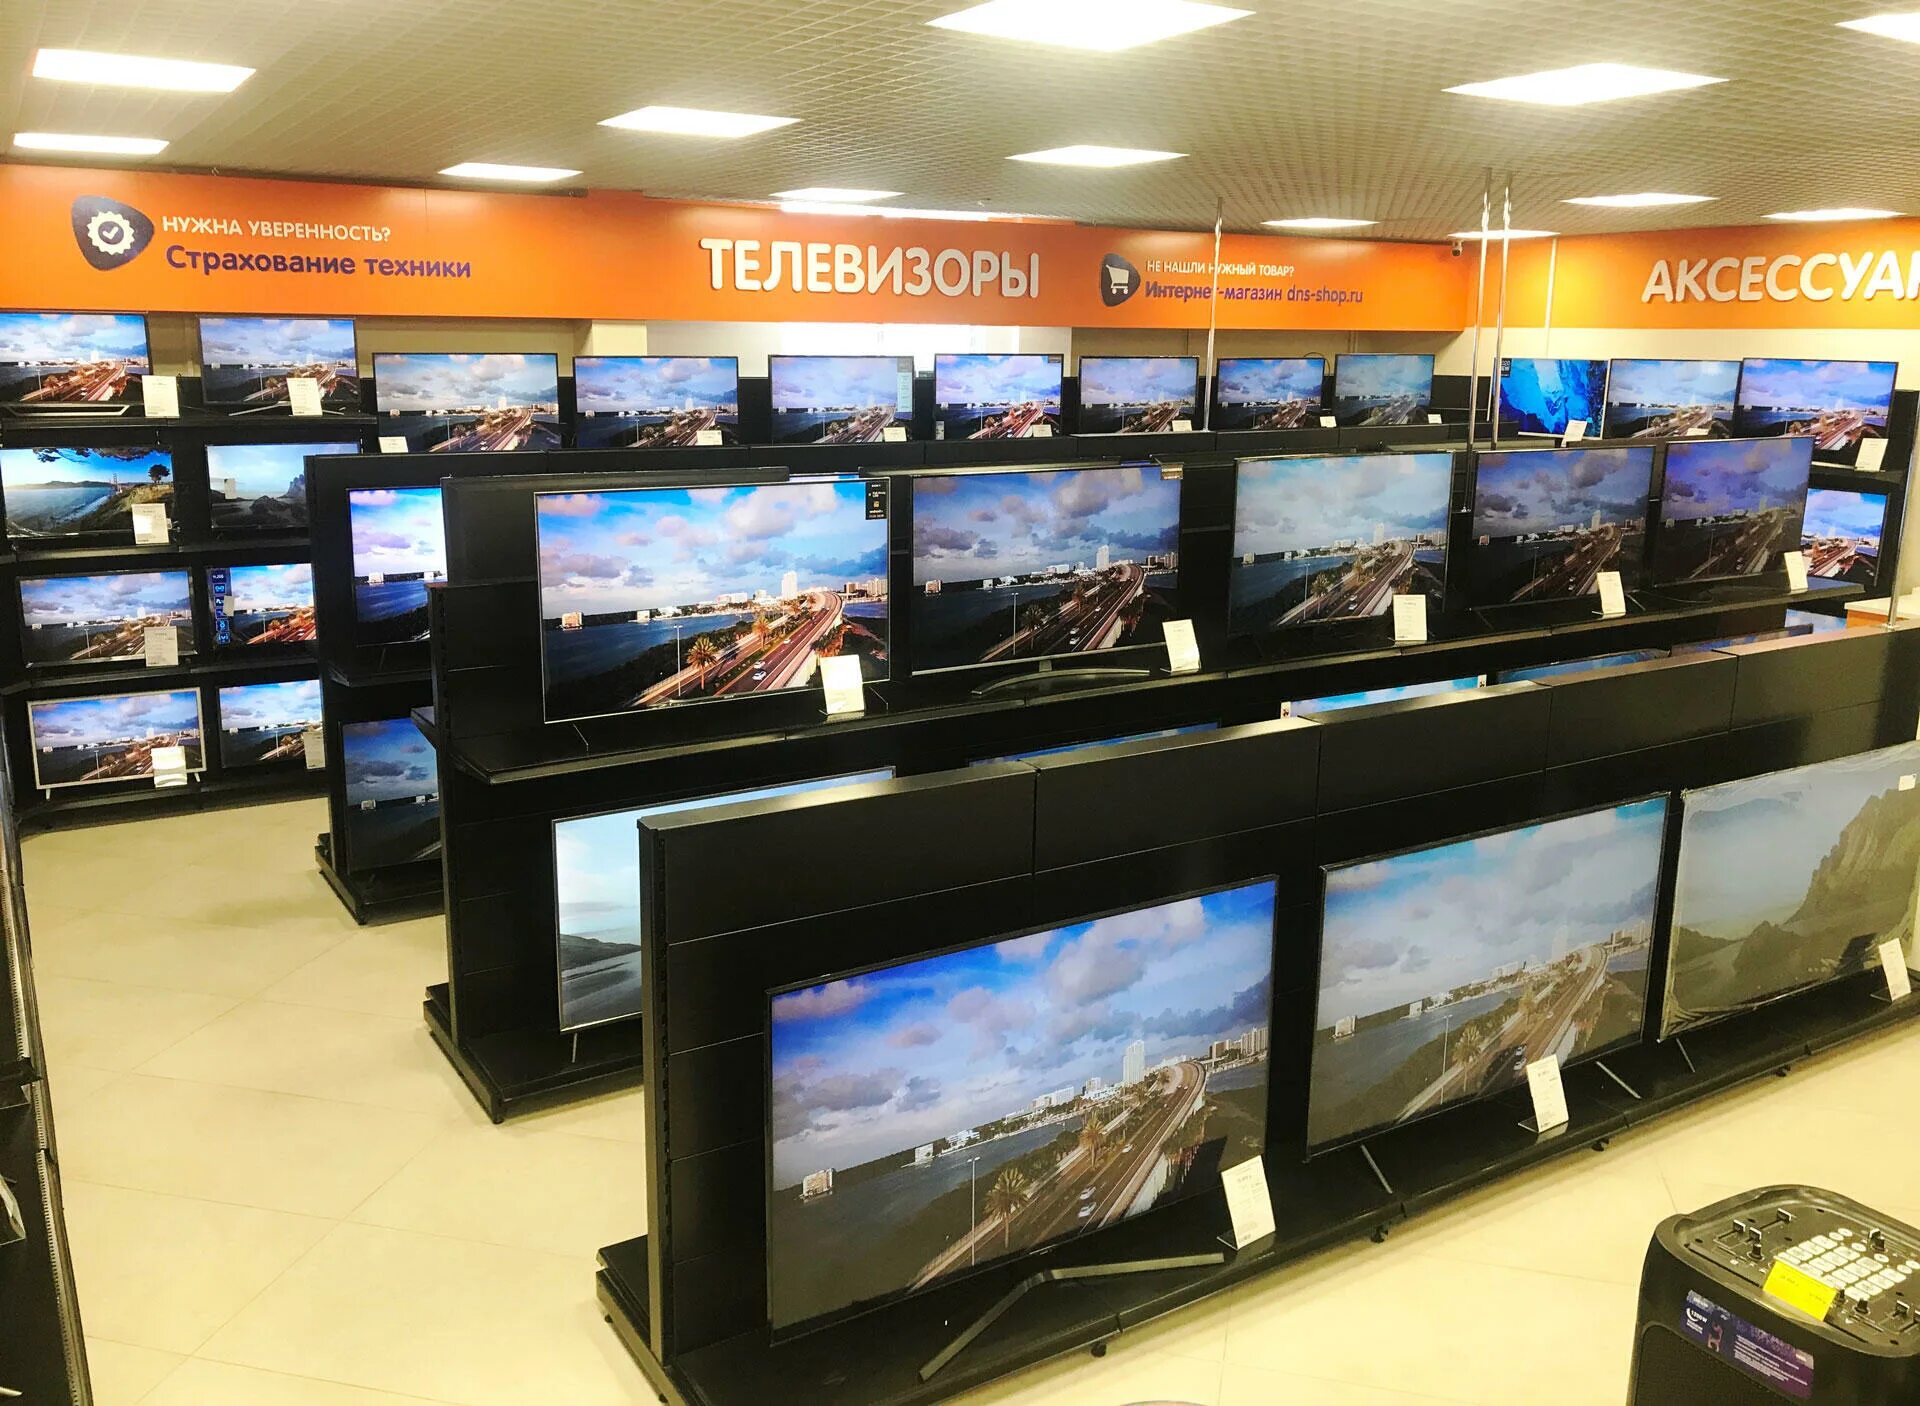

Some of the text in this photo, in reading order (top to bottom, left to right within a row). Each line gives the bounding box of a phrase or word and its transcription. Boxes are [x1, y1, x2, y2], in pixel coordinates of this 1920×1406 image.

[162, 216, 392, 242] НУЖНА УВЕРЕННОСТЬ?
[166, 245, 472, 279] Страхование техники
[699, 238, 1040, 299] ТЕЛЕВИЗОРЫ
[1147, 261, 1161, 273] НЕ
[1163, 261, 1205, 274] НАШЛИ
[1259, 264, 1295, 277] ТОВАР?
[1145, 281, 1363, 305] Интерне-магазин dns-shop.ru
